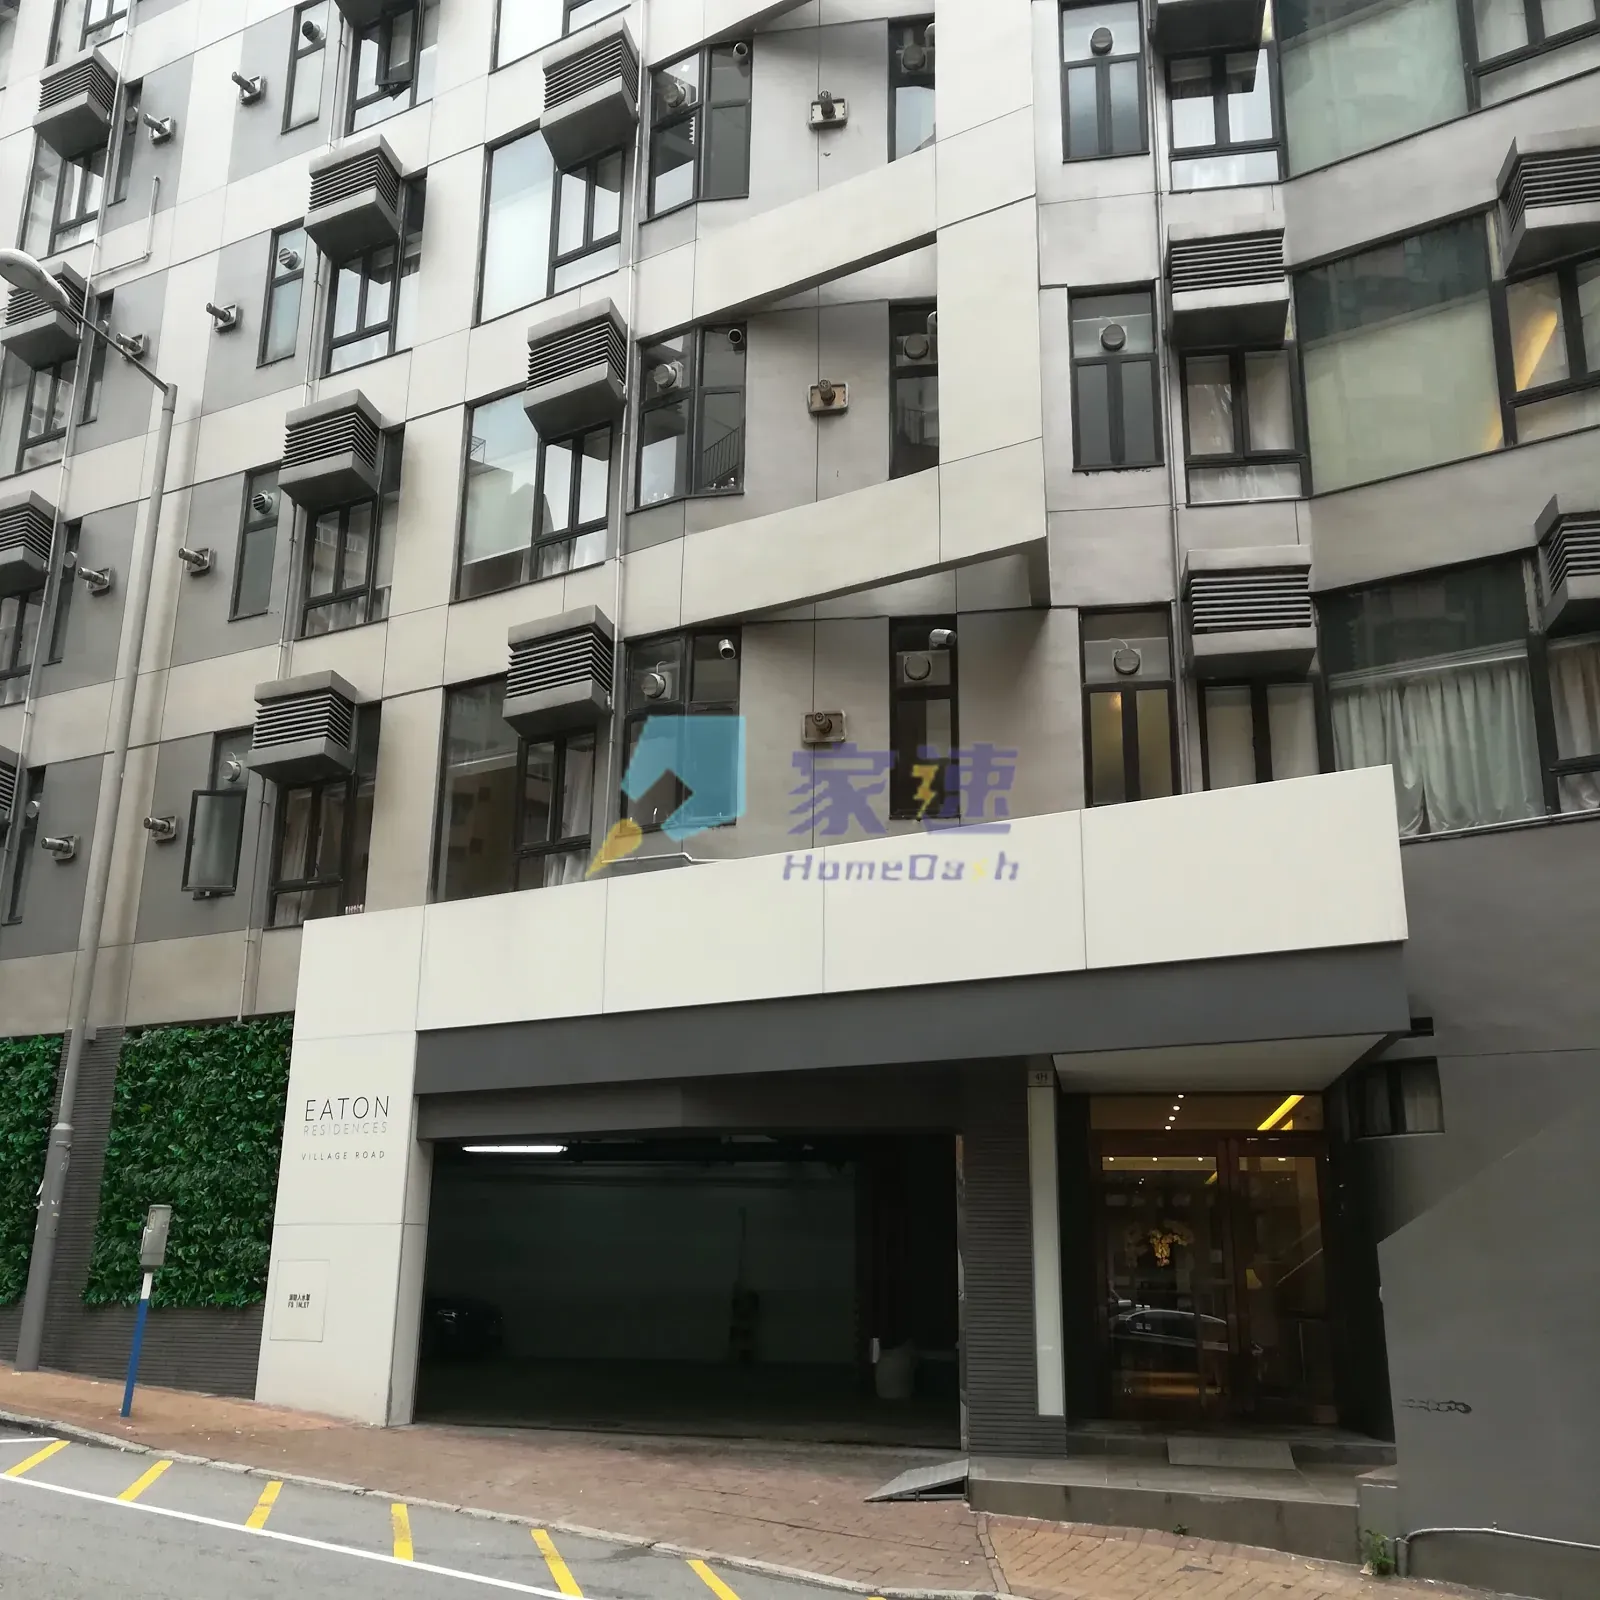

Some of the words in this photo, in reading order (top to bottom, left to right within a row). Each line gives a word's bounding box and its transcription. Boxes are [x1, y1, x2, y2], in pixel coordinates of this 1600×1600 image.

[305, 1095, 389, 1121] EATON
[303, 1121, 387, 1136] RESIDENCES
[301, 1151, 348, 1161] VILLAGE
[355, 1150, 385, 1159] ROAD
